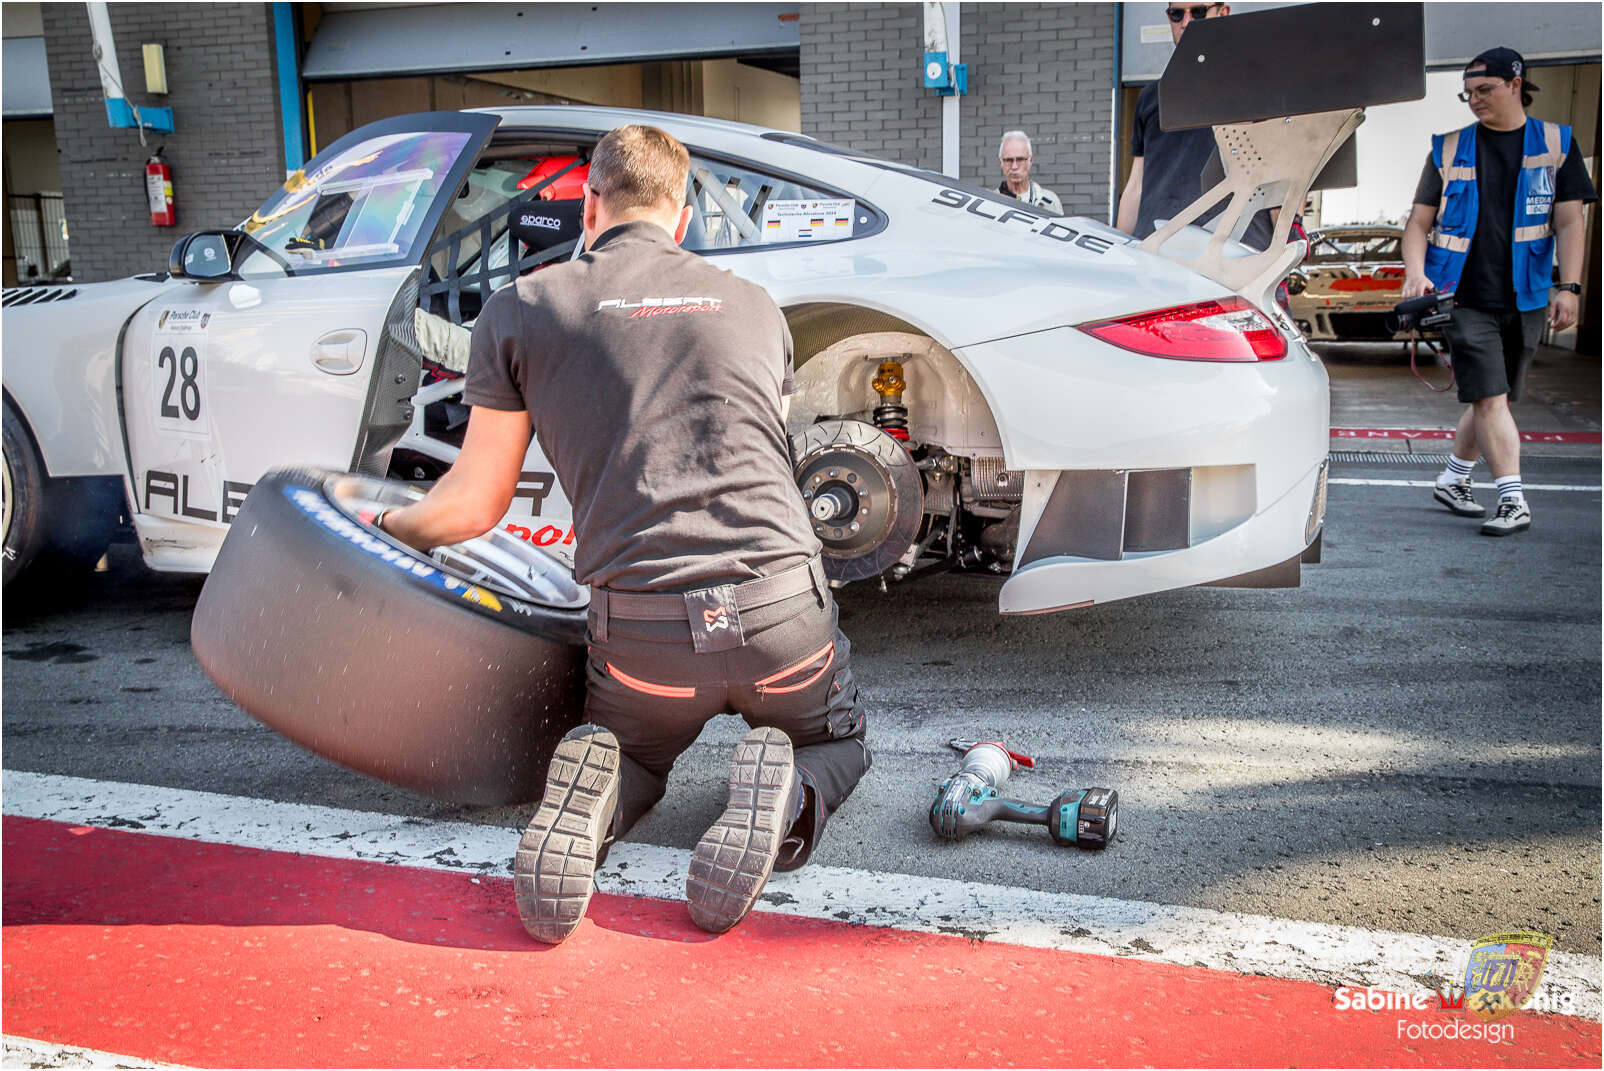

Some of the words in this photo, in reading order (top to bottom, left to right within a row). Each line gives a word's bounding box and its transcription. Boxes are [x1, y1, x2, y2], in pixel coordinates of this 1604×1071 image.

[1526, 196, 1552, 205] MEDIA
[520, 214, 561, 228] sparco
[931, 189, 1114, 255] 9LF.DE
[158, 346, 200, 421] 28
